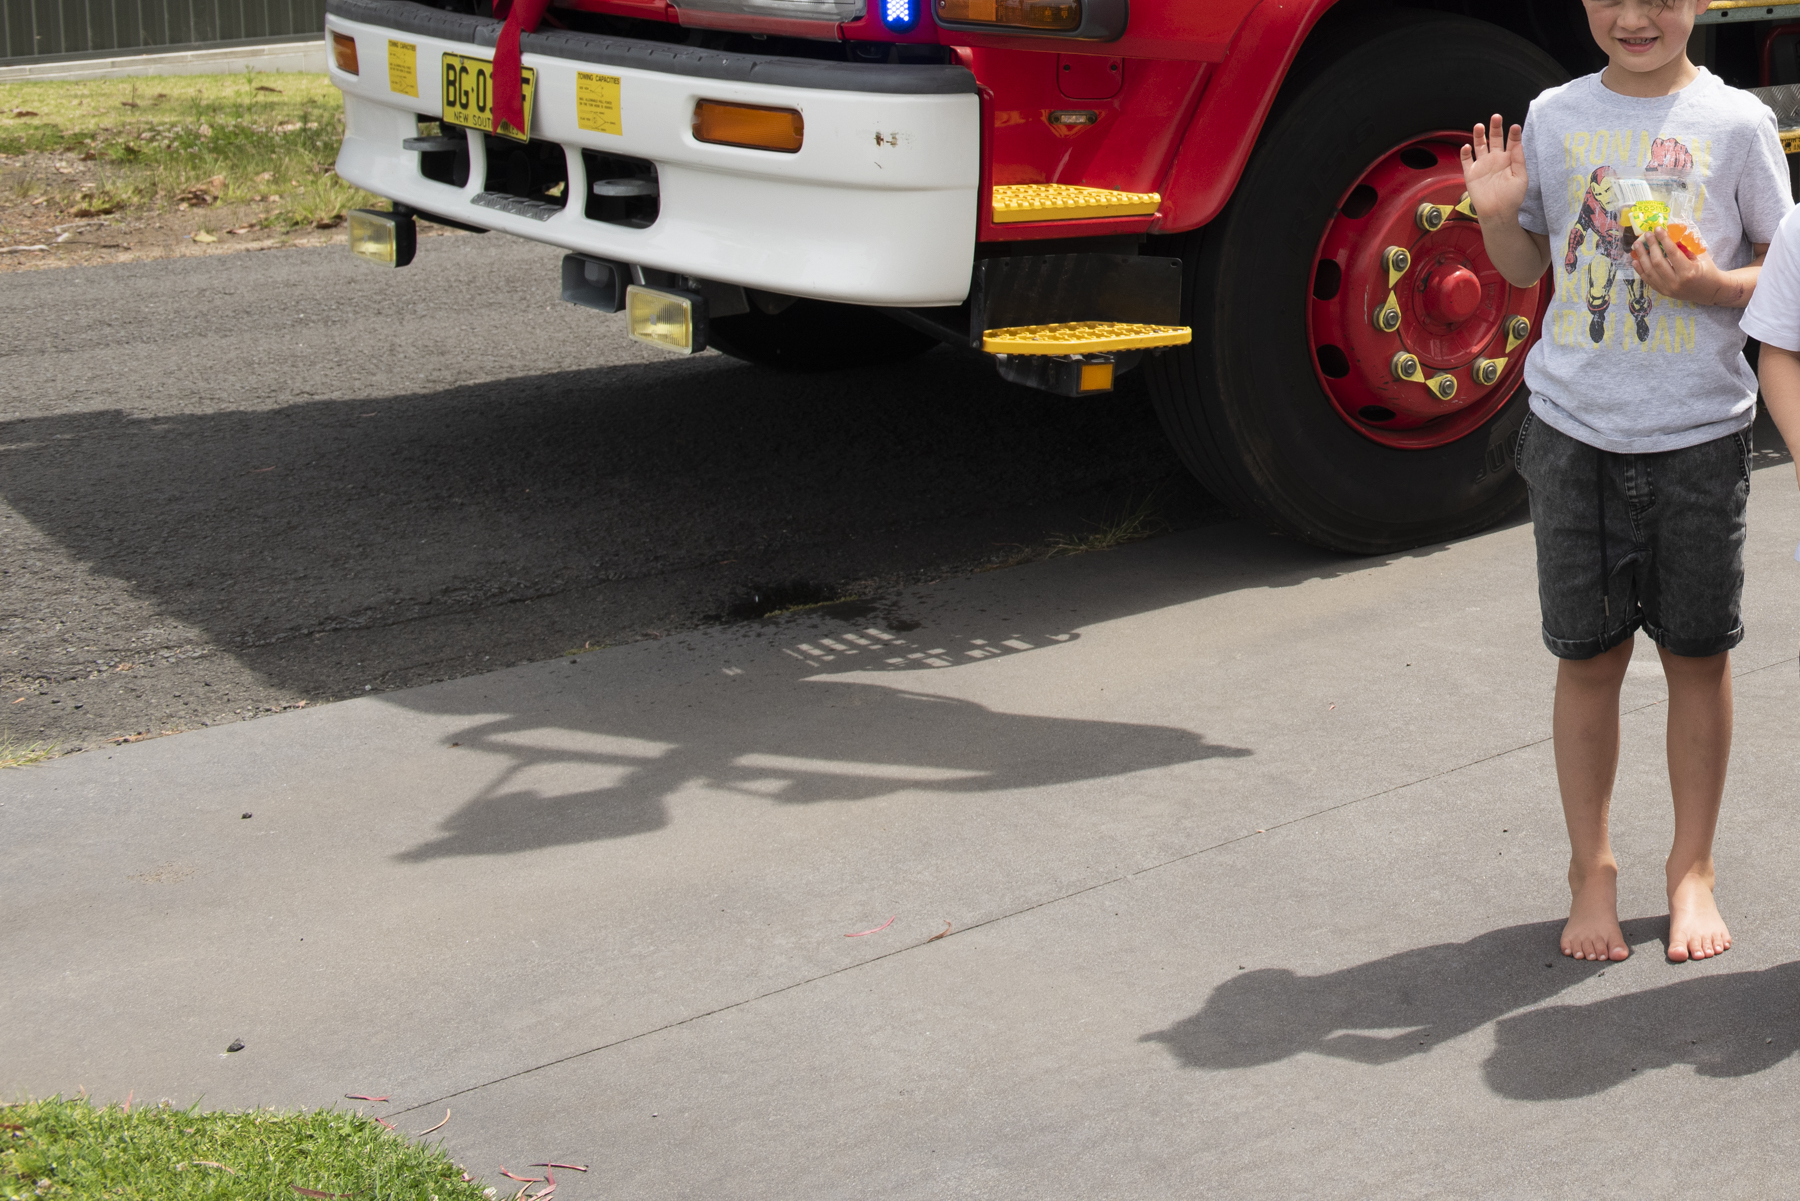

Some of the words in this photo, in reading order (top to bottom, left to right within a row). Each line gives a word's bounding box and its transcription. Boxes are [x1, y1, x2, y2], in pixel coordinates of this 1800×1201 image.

[454, 111, 469, 124] NEW
[472, 114, 493, 128] SOUT
[1564, 129, 1633, 169] IRON
